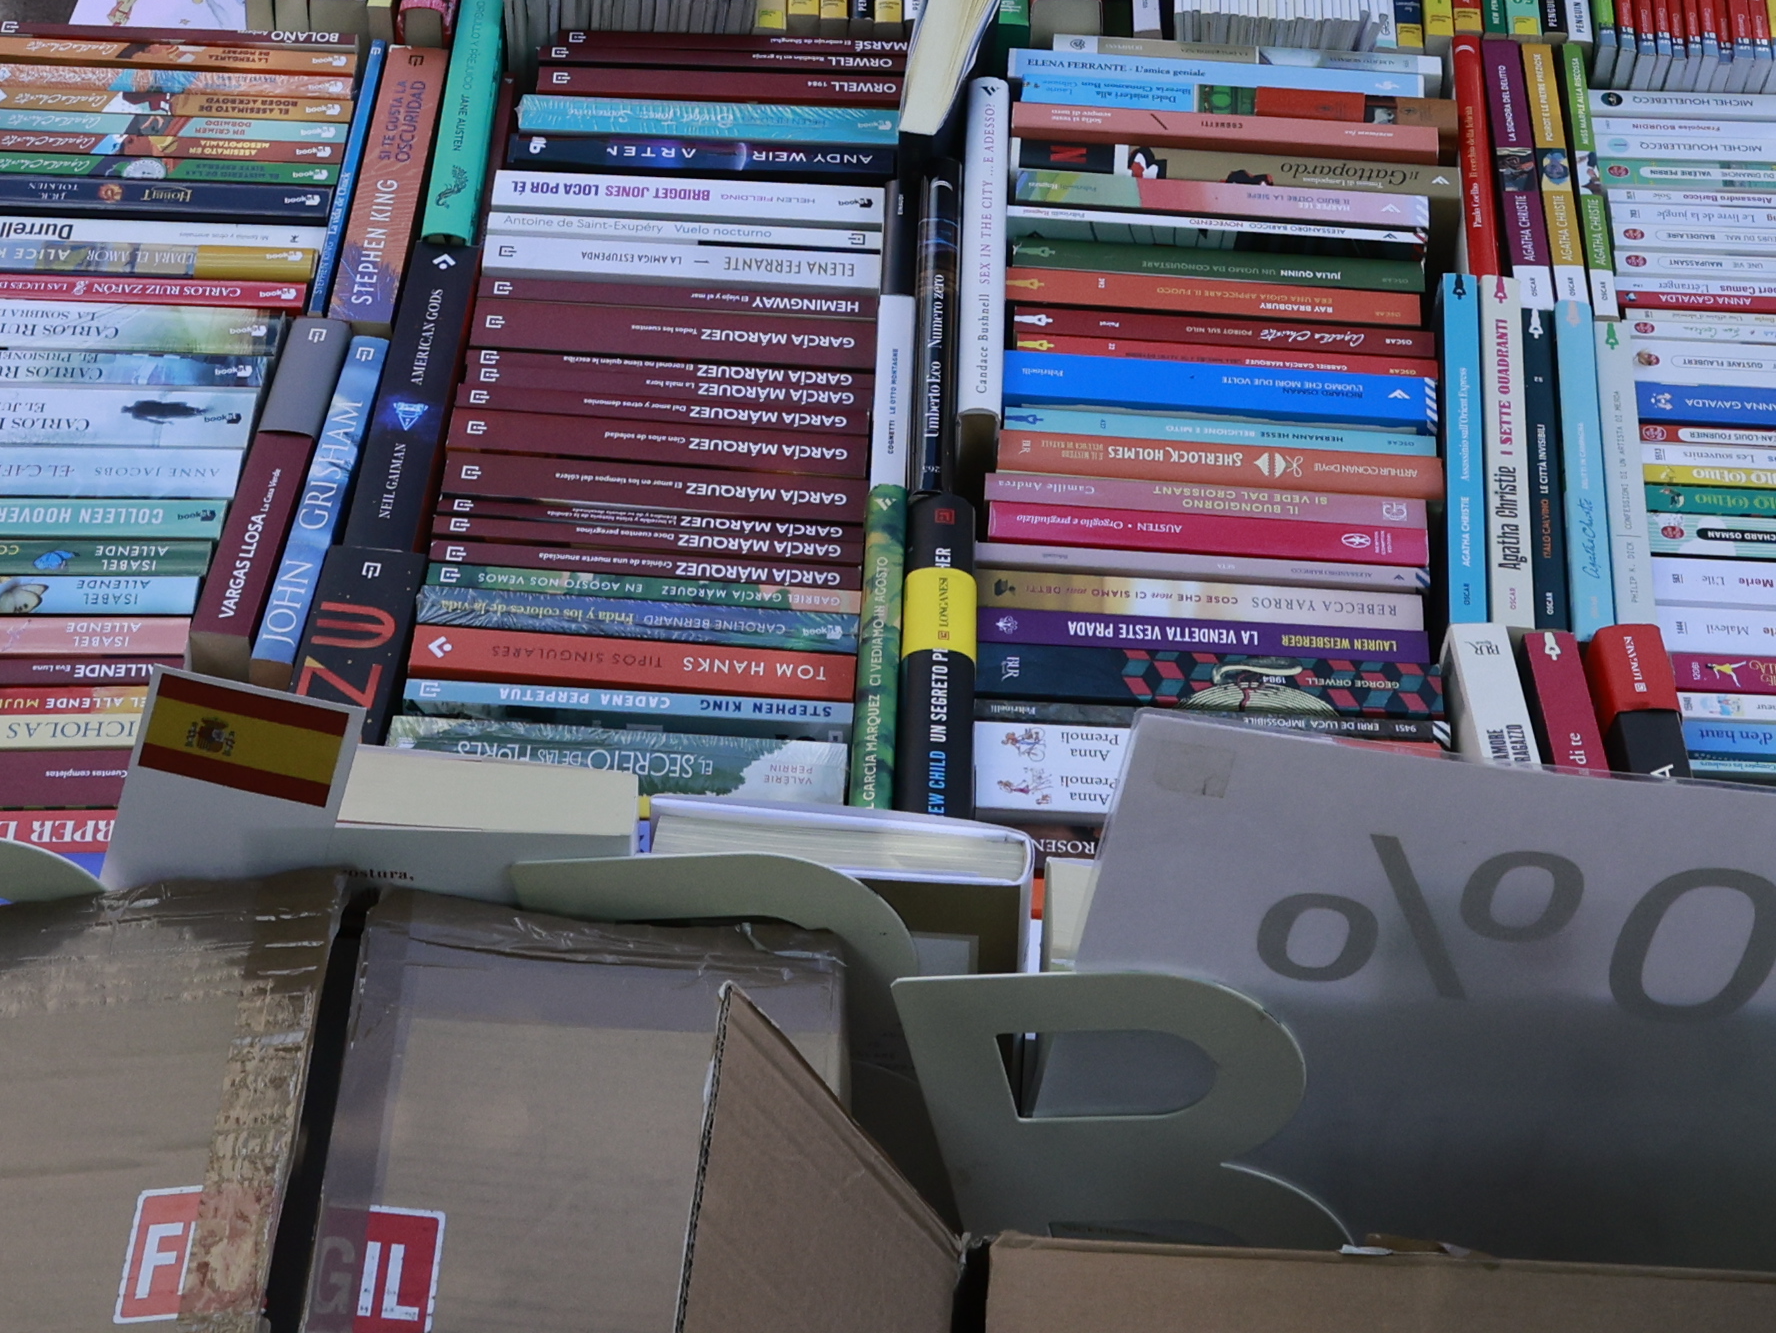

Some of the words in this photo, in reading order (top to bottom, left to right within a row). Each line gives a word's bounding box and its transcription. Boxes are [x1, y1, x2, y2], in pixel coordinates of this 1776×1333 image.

[270, 30, 340, 44] BOLAÑO
[830, 81, 896, 93] ORWELL
[1280, 161, 1406, 186] Gattopardo
[511, 181, 527, 197] ÉL
[530, 182, 560, 195] POR
[563, 183, 599, 197] LOCA
[605, 185, 650, 199] JONES
[653, 187, 711, 201] BRIDGET
[0, 221, 74, 240] Durrell
[503, 215, 554, 230] Antoine
[557, 217, 574, 231] de
[576, 218, 664, 235] Saint-Exupéry
[674, 221, 708, 235] Vuelo
[712, 224, 772, 239] nocturno
[13, 248, 70, 262] ALICE
[723, 256, 802, 276] FERRANTE
[806, 261, 855, 278] ELENA
[92, 282, 142, 296] ZAFÓN
[146, 284, 178, 296] RUIZ
[182, 285, 241, 298] CARLOS
[752, 296, 859, 312] HEMINGWAY
[1658, 293, 1714, 306] GAVALDA
[1716, 296, 1751, 306] ANNA
[410, 323, 435, 387] AMERICAN
[425, 288, 444, 328] GODS
[689, 437, 778, 458] MÁRQUEZ
[782, 443, 847, 460] GARCÍA
[1107, 445, 1164, 463] HOLMES
[1167, 447, 1243, 467] SHERLOCK
[79, 507, 164, 524] COLLEEN
[94, 544, 169, 557] ALLENDE
[100, 558, 157, 571] ISABEL
[261, 560, 312, 649] JOHN
[1251, 596, 1318, 612] YARROS
[1321, 600, 1397, 618] REBECCA
[1067, 620, 1114, 638] PRADA
[1118, 623, 1161, 640] VESTE
[1165, 626, 1237, 644] VENDETTA
[1240, 629, 1258, 646] LA
[1281, 634, 1352, 650] WEISBERGER
[1354, 637, 1397, 652] LAUREN
[682, 656, 765, 676] HANKS
[776, 662, 826, 681] TOM
[45, 697, 124, 709] ALLENDE
[499, 687, 590, 704] PERPETUA
[600, 693, 671, 709] CADENA
[699, 699, 742, 713] KING
[752, 701, 832, 718] STEPHEN
